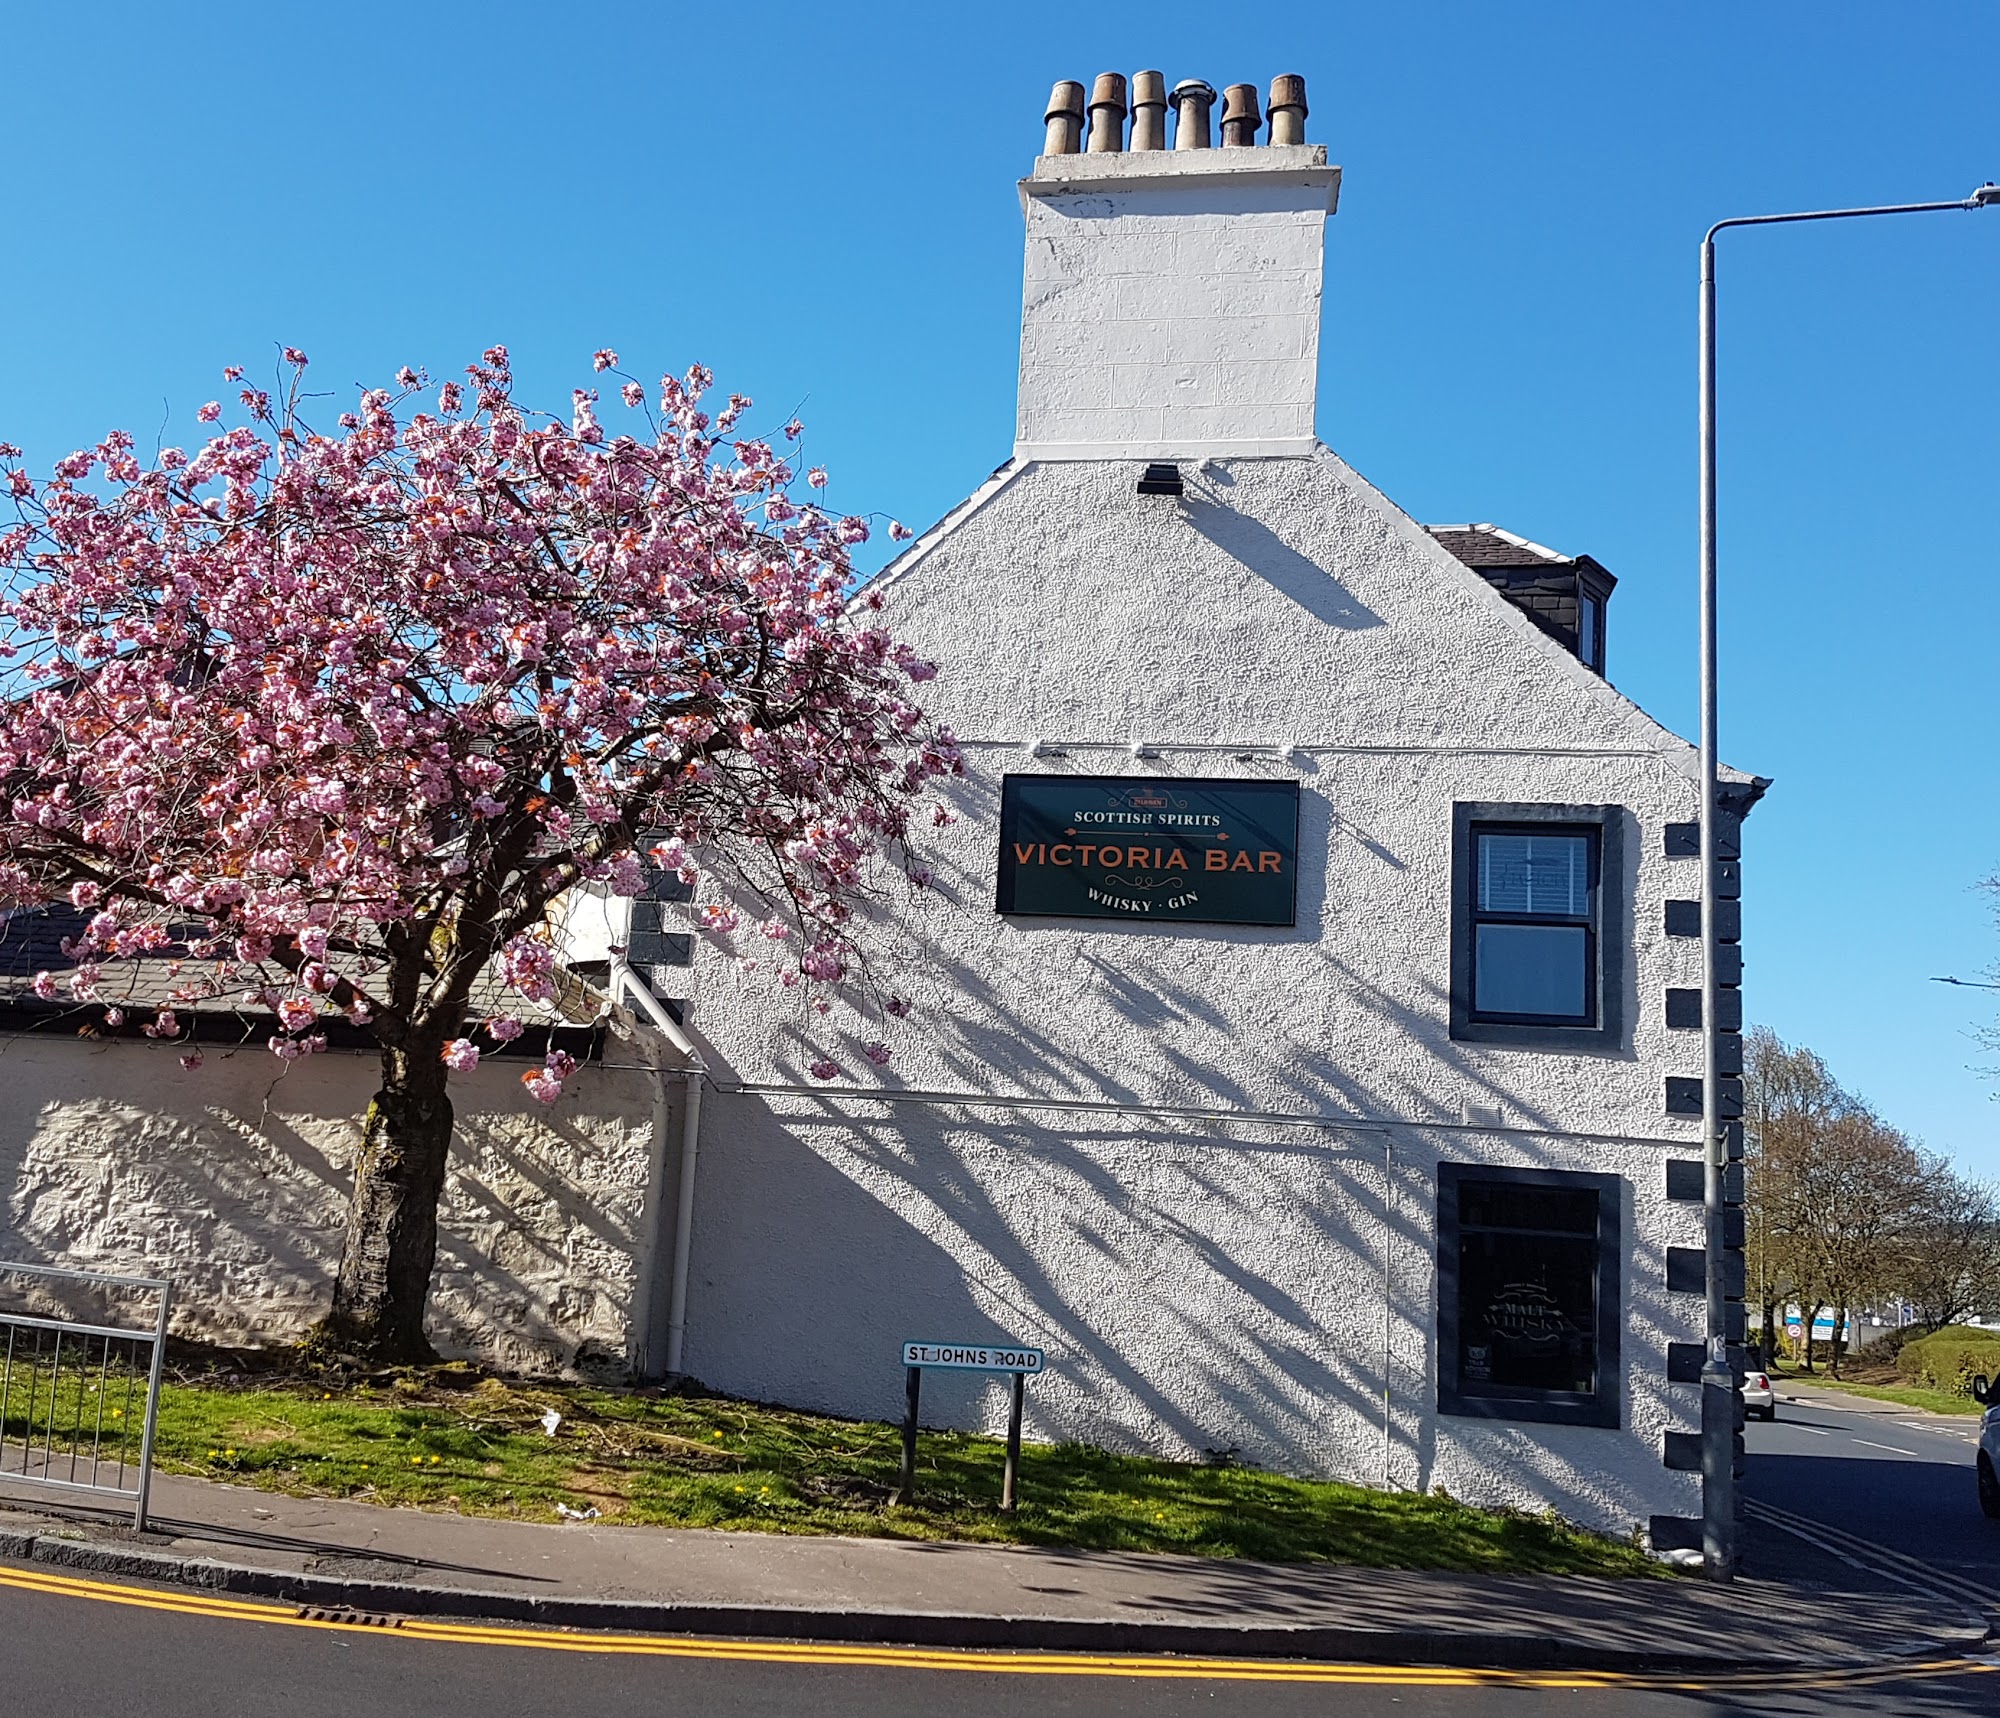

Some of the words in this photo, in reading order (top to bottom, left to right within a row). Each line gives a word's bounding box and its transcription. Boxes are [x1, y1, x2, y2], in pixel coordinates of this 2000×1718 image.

[1074, 811, 1153, 825] SCOTTISH
[1158, 813, 1220, 827] SPIRITS
[1014, 843, 1189, 870] VICTORIA
[1205, 849, 1282, 874] BAR
[1088, 886, 1152, 912] WHISKY
[1168, 890, 1199, 910] GIN
[1505, 1303, 1546, 1316] MALT
[1483, 1314, 1564, 1330] WHISKY
[908, 1346, 928, 1361] ST
[935, 1348, 987, 1365] JOHNS
[993, 1351, 1037, 1367] ROAD
